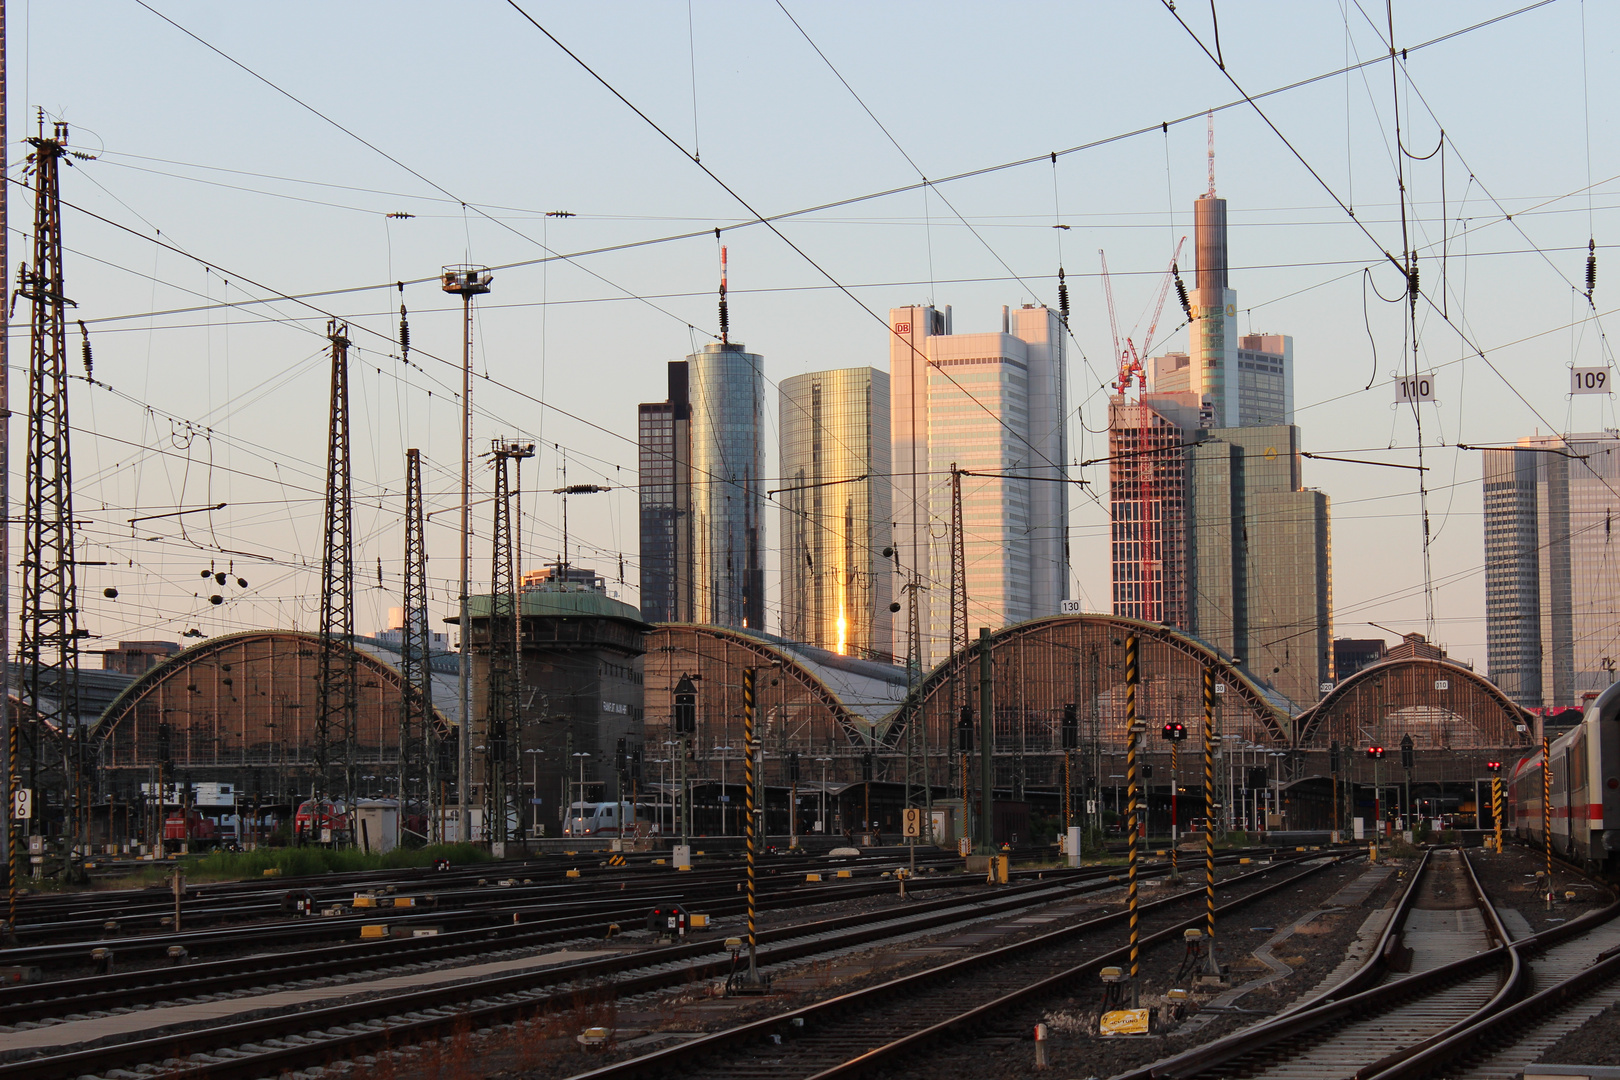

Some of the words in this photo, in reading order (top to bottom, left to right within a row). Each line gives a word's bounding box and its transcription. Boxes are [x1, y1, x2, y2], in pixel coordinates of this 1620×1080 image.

[1400, 380, 1430, 398] 110
[1575, 372, 1606, 389] 109
[1063, 602, 1079, 611] 130
